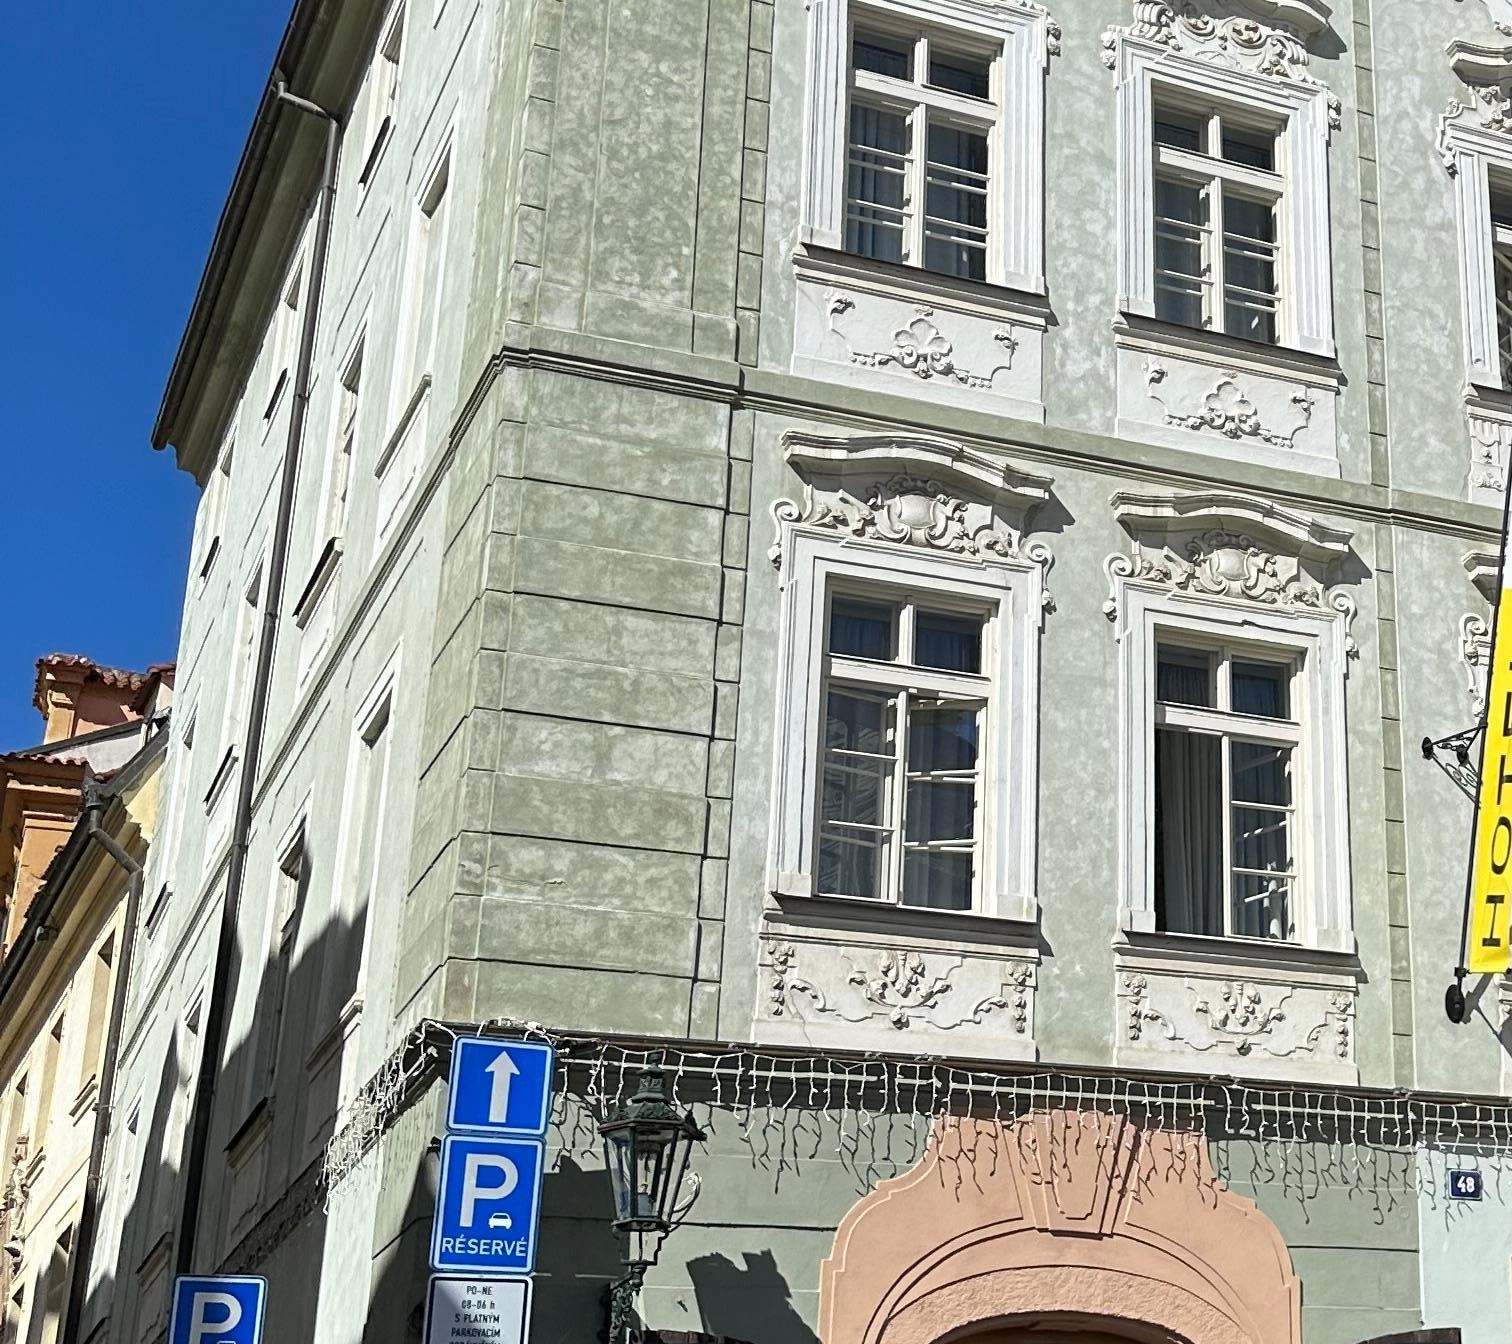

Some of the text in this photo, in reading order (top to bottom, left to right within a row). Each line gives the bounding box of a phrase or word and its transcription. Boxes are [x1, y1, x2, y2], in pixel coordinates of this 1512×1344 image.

[460, 1153, 518, 1227] P
[1457, 1175, 1475, 1193] 48
[441, 1234, 528, 1257] RÉSERVÉ
[454, 1312, 500, 1324] S PLATNÝM
[450, 1326, 501, 1338] PARKOVACÍM
